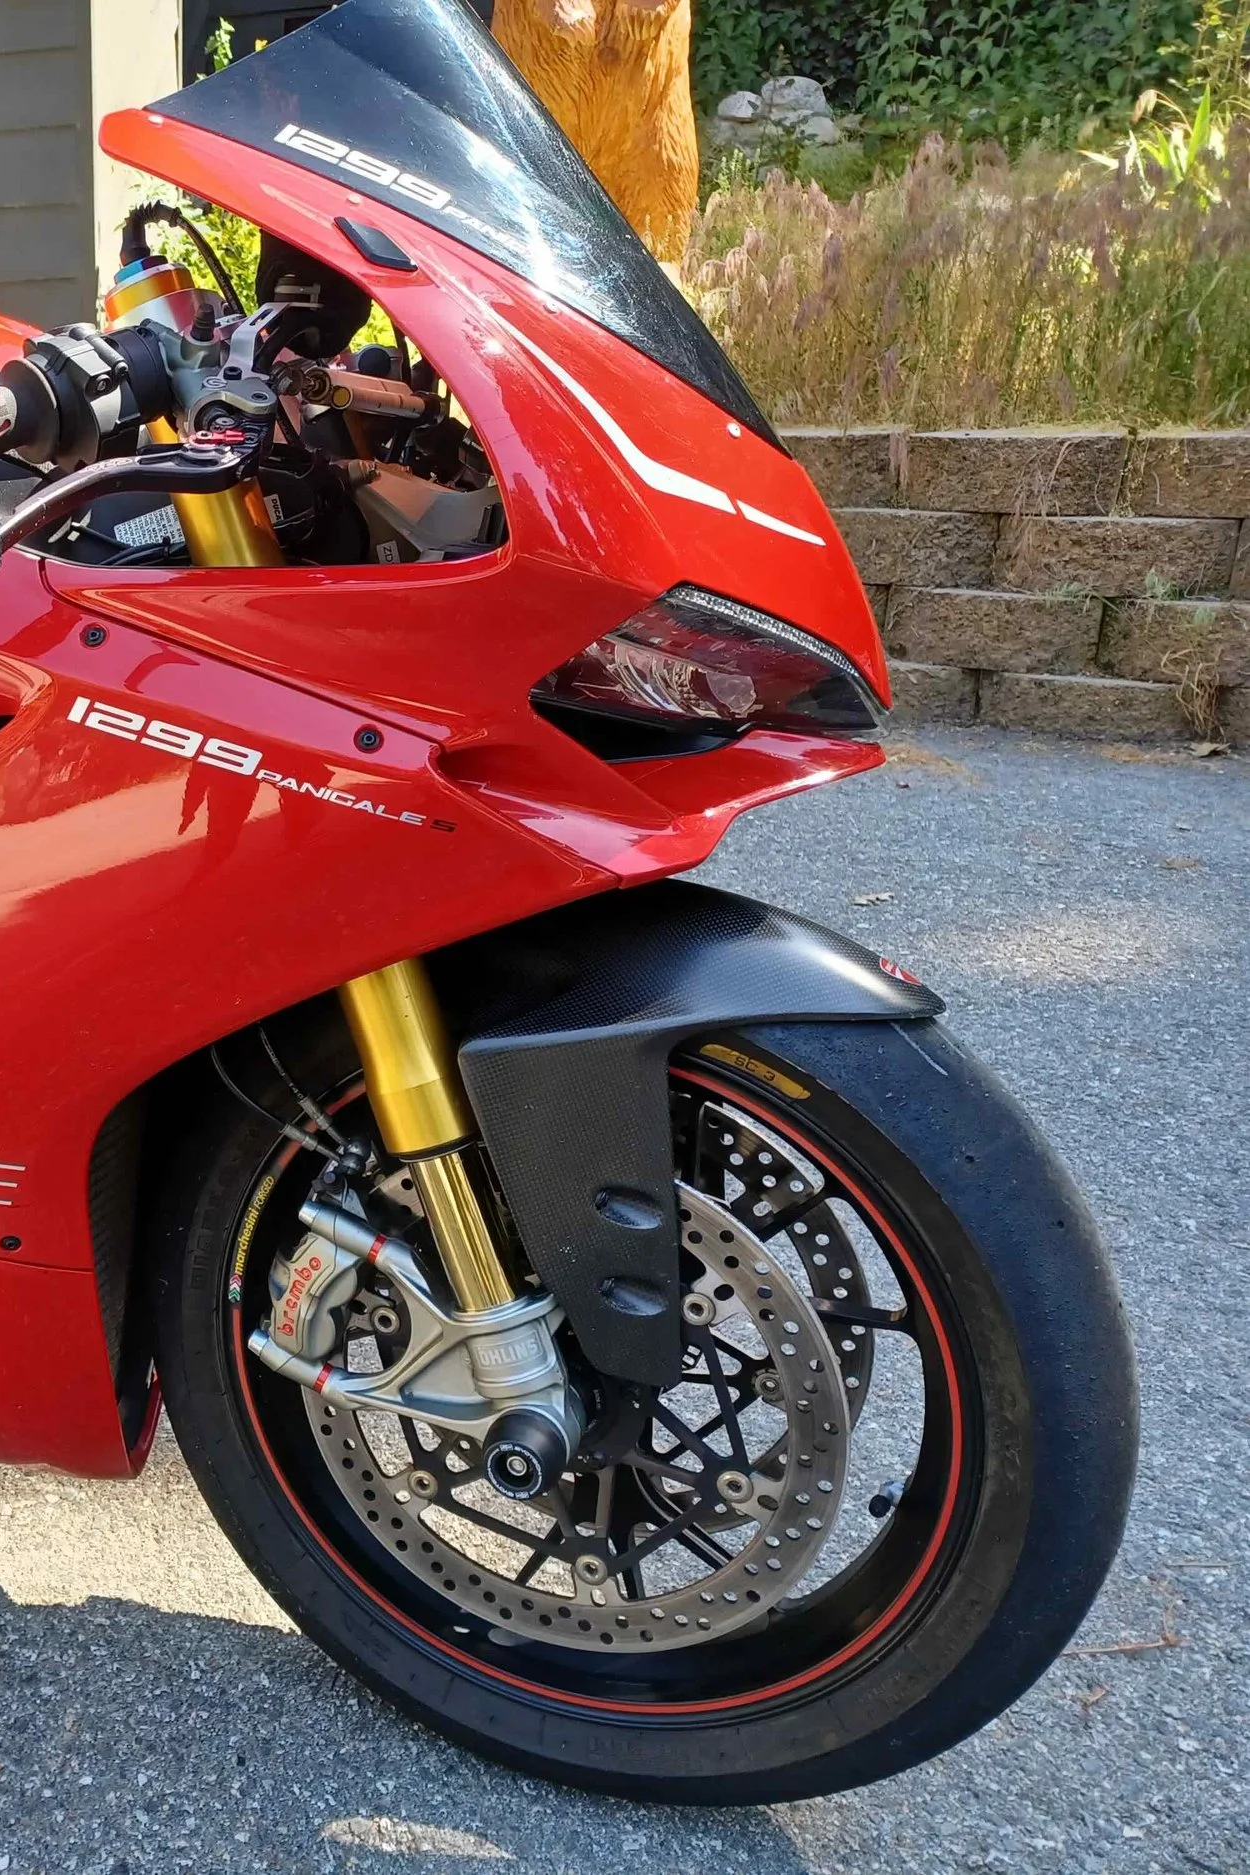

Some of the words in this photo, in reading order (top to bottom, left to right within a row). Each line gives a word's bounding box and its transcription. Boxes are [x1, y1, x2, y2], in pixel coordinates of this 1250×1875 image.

[274, 123, 451, 208] 1299
[67, 695, 263, 776] 1299
[255, 769, 427, 827] PANIGALE
[429, 818, 459, 833] S
[734, 1056, 758, 1073] SC
[763, 1070, 775, 1082] 3
[234, 1207, 259, 1276] marchesini
[253, 1175, 275, 1211] FORGED
[277, 1256, 321, 1337] brembo
